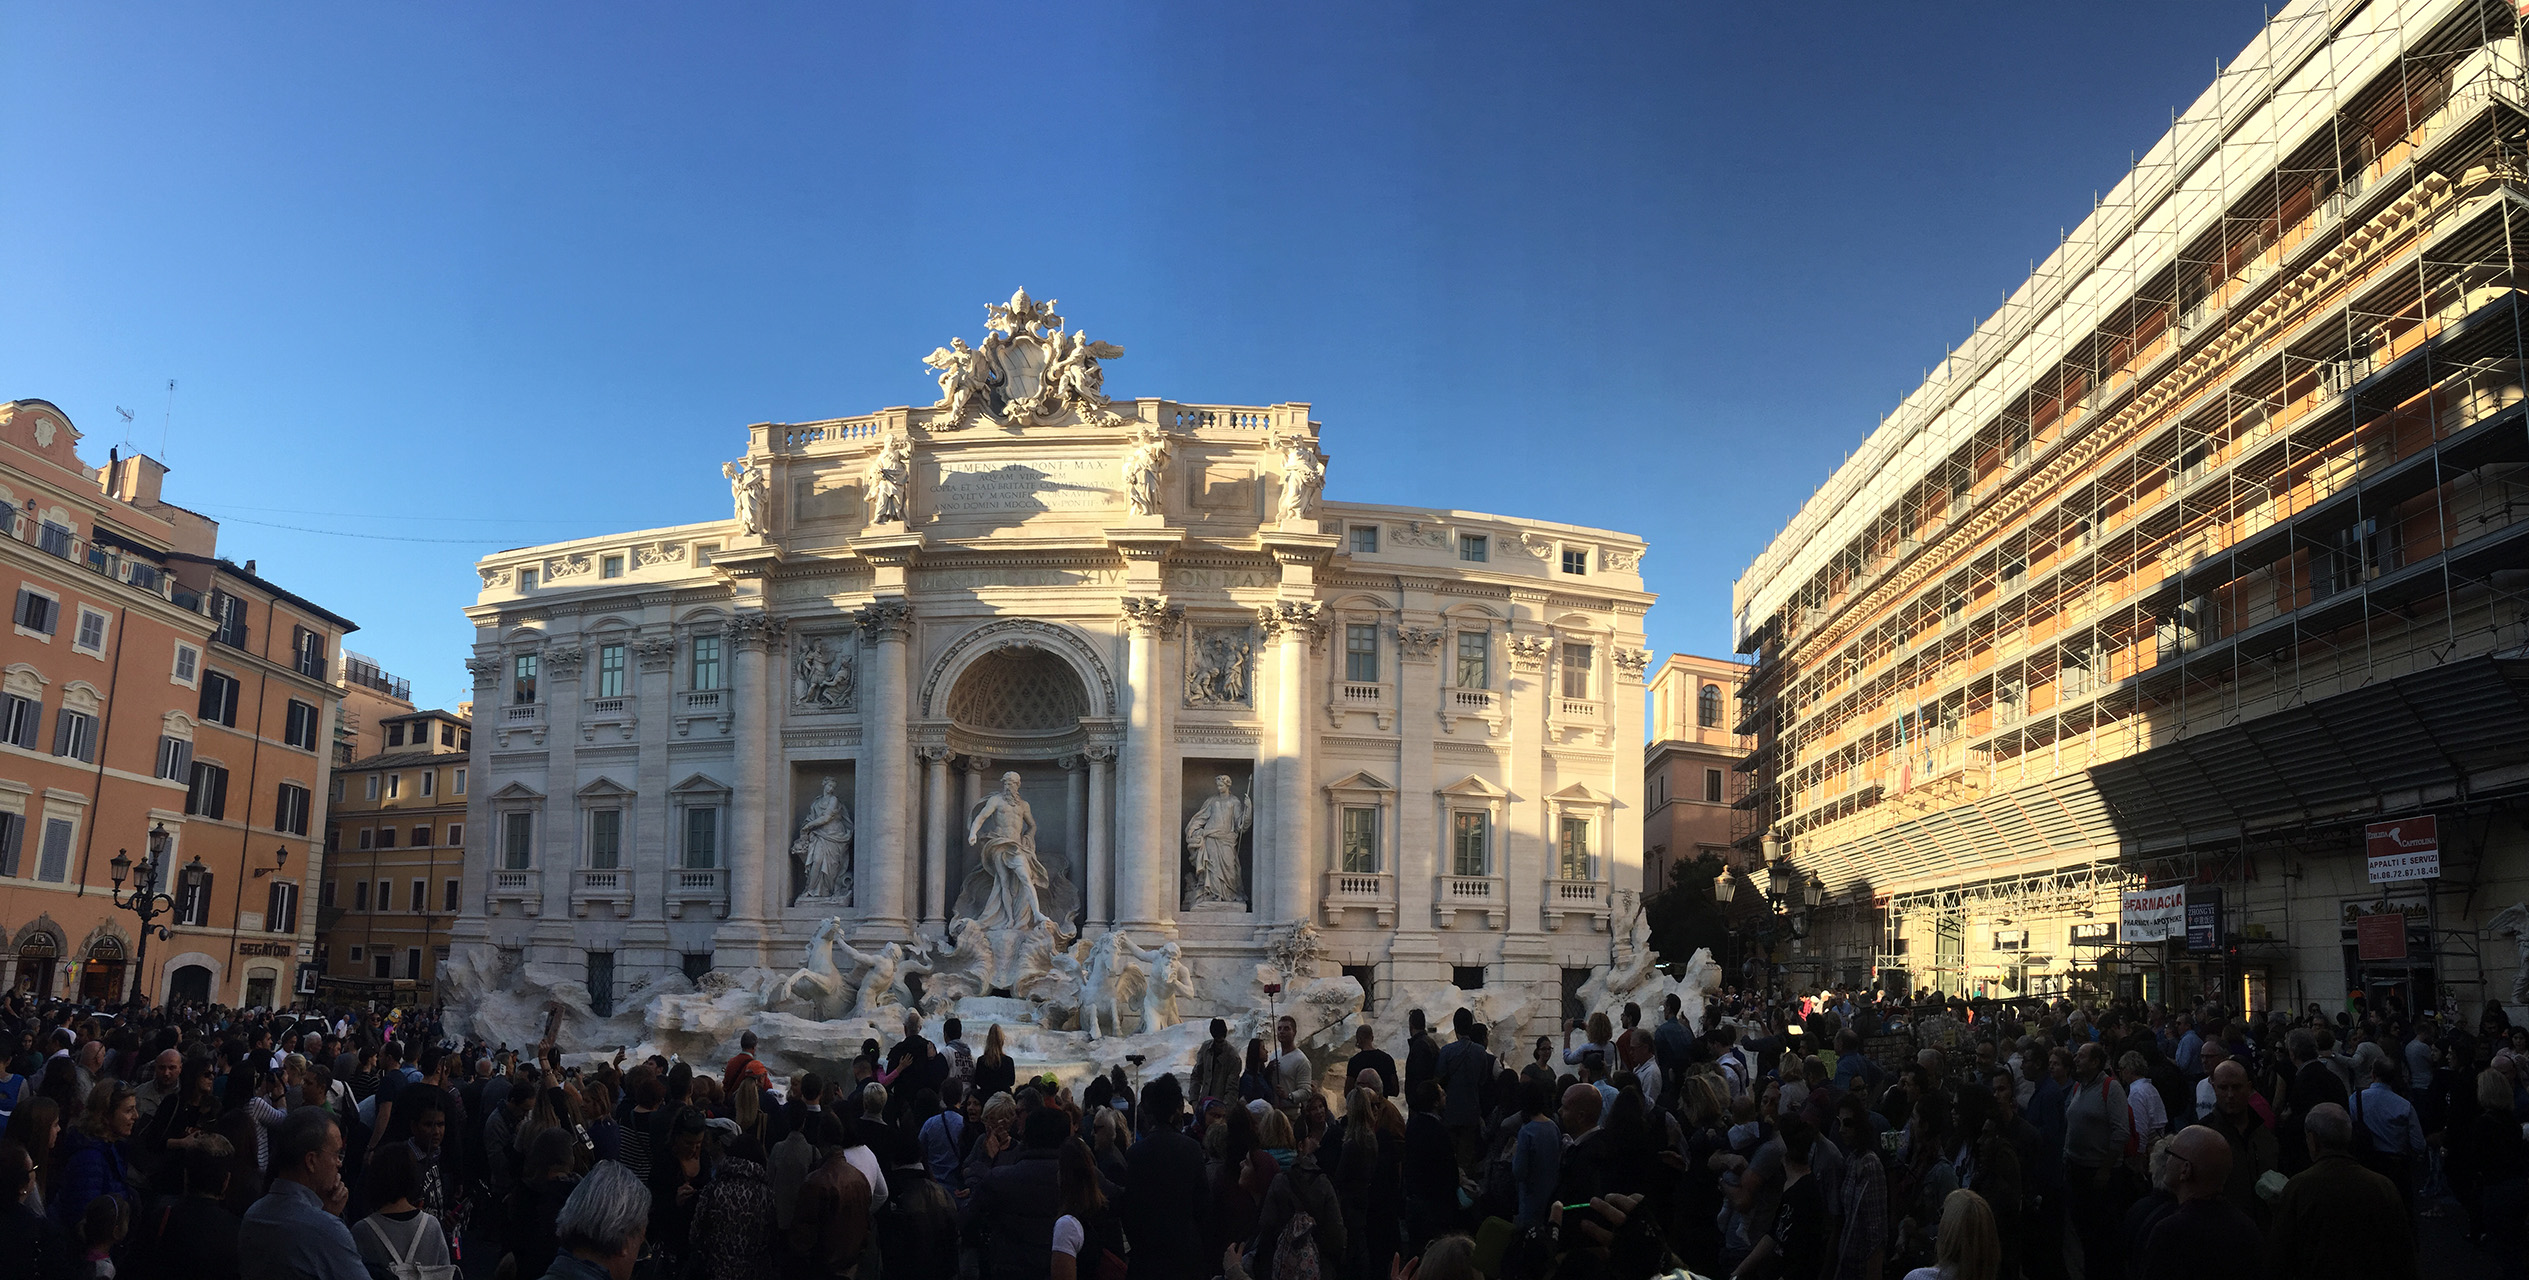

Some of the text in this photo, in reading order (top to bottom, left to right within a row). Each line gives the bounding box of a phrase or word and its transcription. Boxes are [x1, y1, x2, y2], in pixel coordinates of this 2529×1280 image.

[979, 472, 1067, 482] AQVAM VIRGINEM
[929, 483, 956, 493] COPIA
[960, 483, 972, 491] ET
[932, 502, 961, 512] ANNO
[963, 501, 1000, 511] DOMINI
[2369, 859, 2399, 869] APPALTI
[2409, 854, 2438, 865] SERVIZI
[2129, 892, 2183, 912] FARMACIA
[239, 942, 291, 957] SEGATORI
